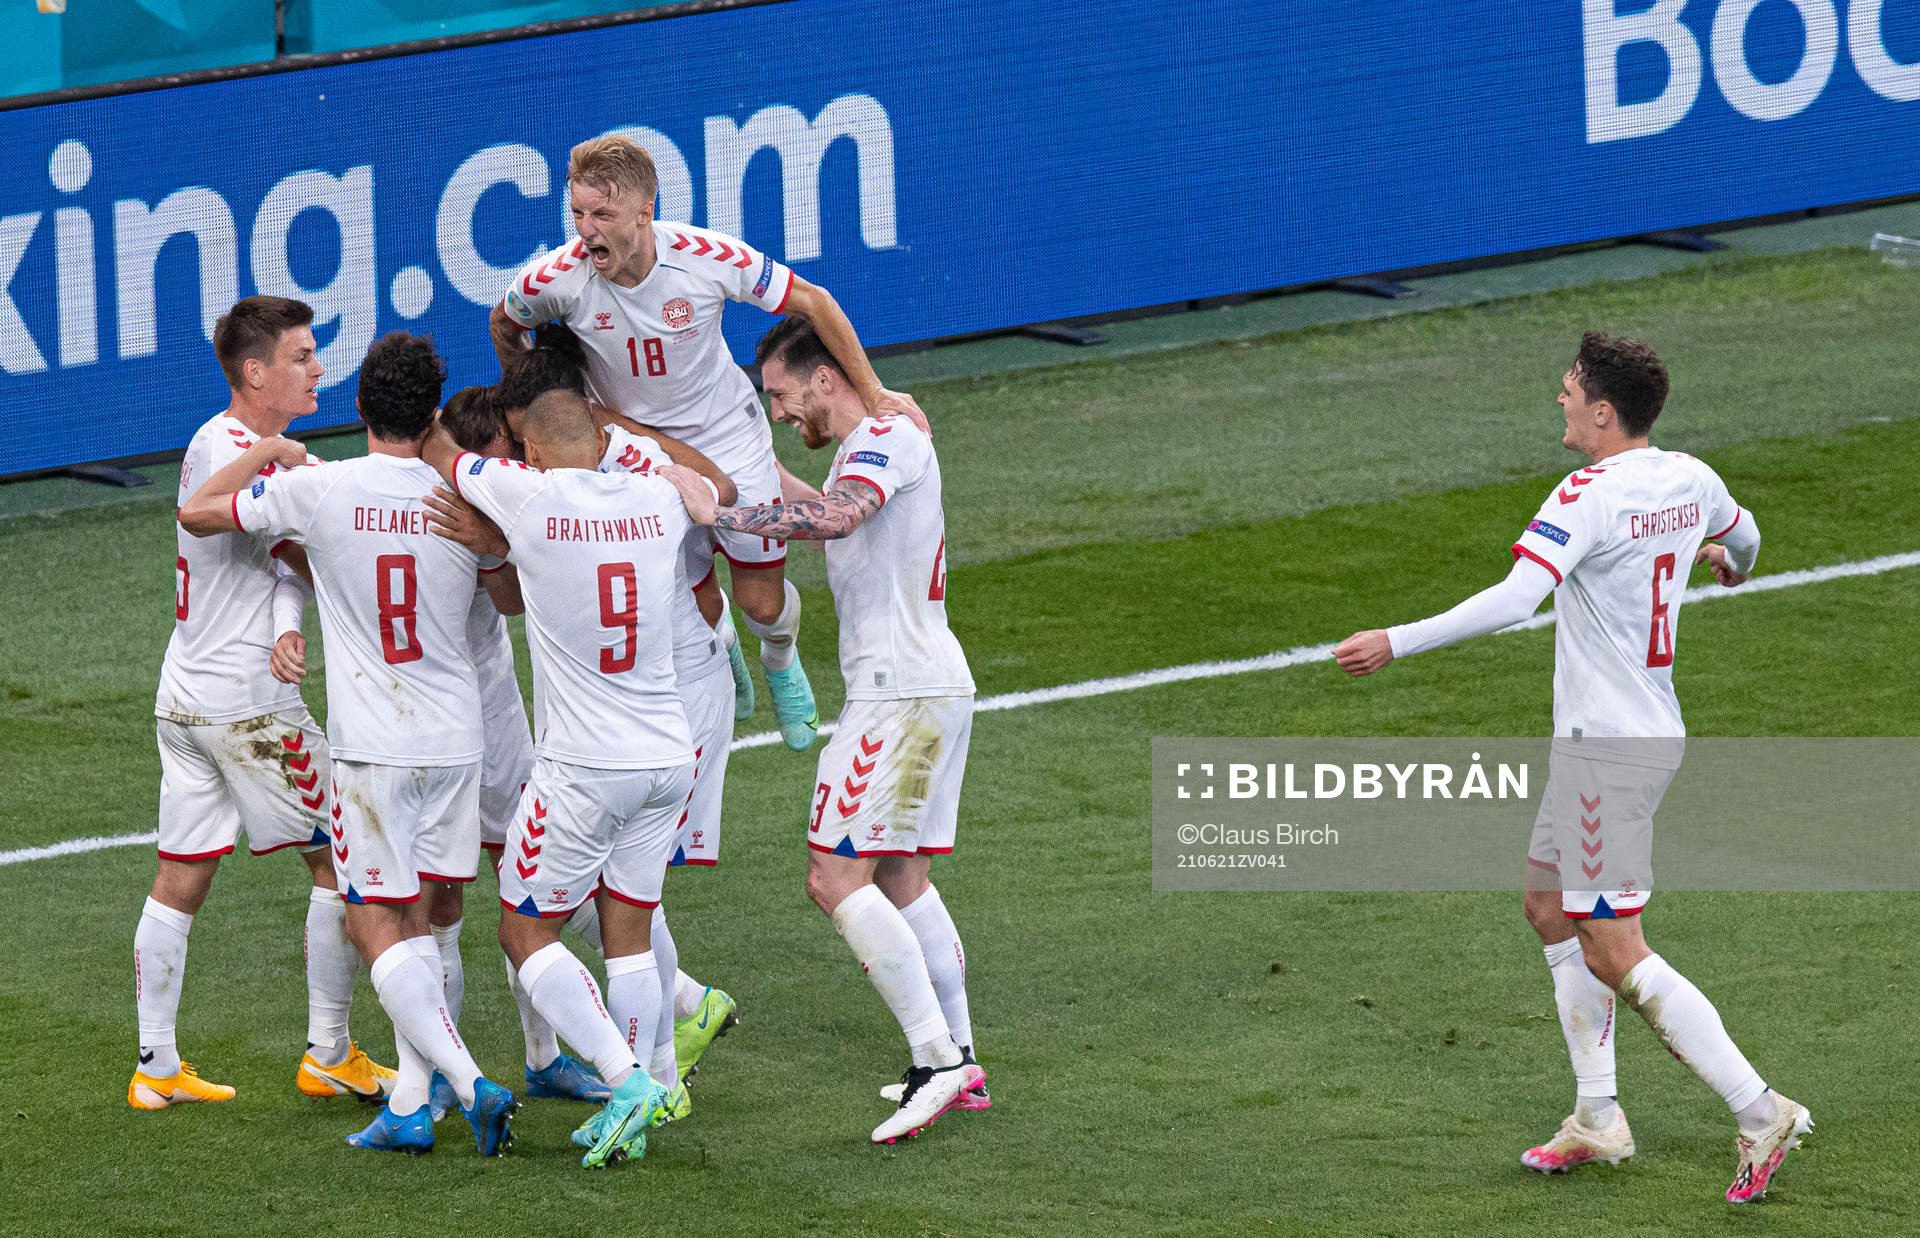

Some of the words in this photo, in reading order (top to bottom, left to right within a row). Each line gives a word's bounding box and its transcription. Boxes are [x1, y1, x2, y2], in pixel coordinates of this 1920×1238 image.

[626, 336, 667, 377] 18
[857, 453, 887, 465] RESPECT
[354, 506, 430, 535] DELANEY
[547, 515, 664, 542] BRAITHWAITE
[1539, 524, 1569, 542] RESPECT
[1631, 502, 1700, 539] CHRISTENSEN
[376, 554, 423, 665] 8
[597, 562, 638, 674] 9
[1646, 552, 1675, 668] 6
[809, 782, 832, 833] 3
